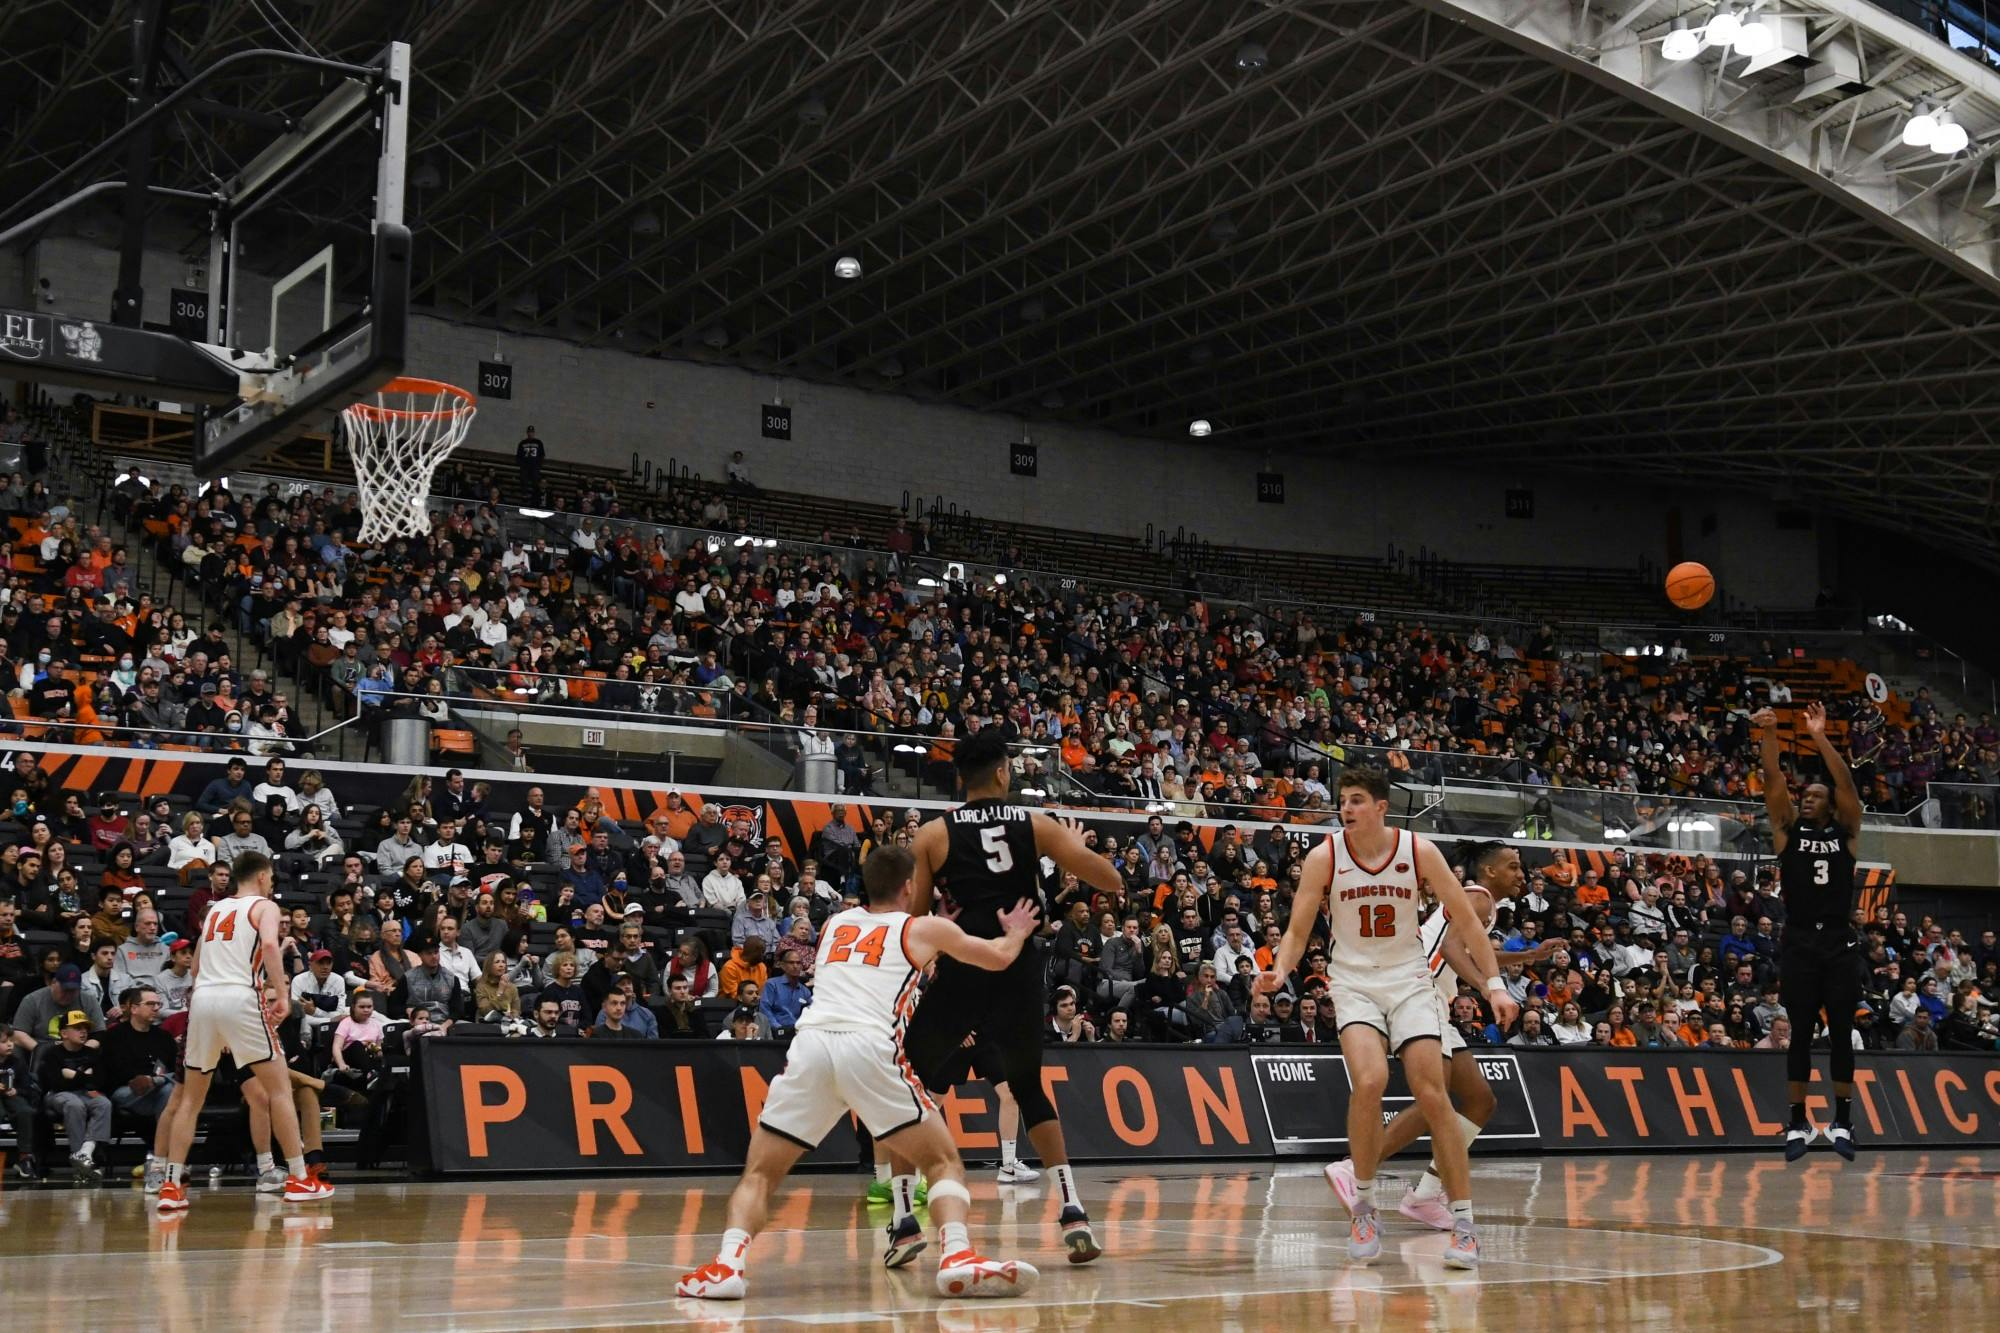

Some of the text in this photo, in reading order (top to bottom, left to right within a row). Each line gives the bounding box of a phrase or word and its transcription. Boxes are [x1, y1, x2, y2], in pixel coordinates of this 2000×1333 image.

[177, 302, 205, 319] 306
[484, 373, 508, 389] 307
[767, 416, 789, 431] 308
[1015, 454, 1034, 467] 309
[1262, 483, 1282, 496] 310
[1061, 579, 1076, 589] 207
[1709, 633, 1725, 642] 209
[587, 731, 602, 743] EXIT
[953, 805, 1026, 823] LORCA-LLOYD
[980, 824, 1014, 873] 5
[1798, 838, 1841, 854] PENN
[1813, 860, 1829, 885] 3
[1340, 884, 1412, 902] PRINCETON
[204, 909, 237, 942] 14
[1359, 903, 1396, 938] 12
[823, 923, 890, 968] 24
[1267, 1062, 1316, 1081] HOME
